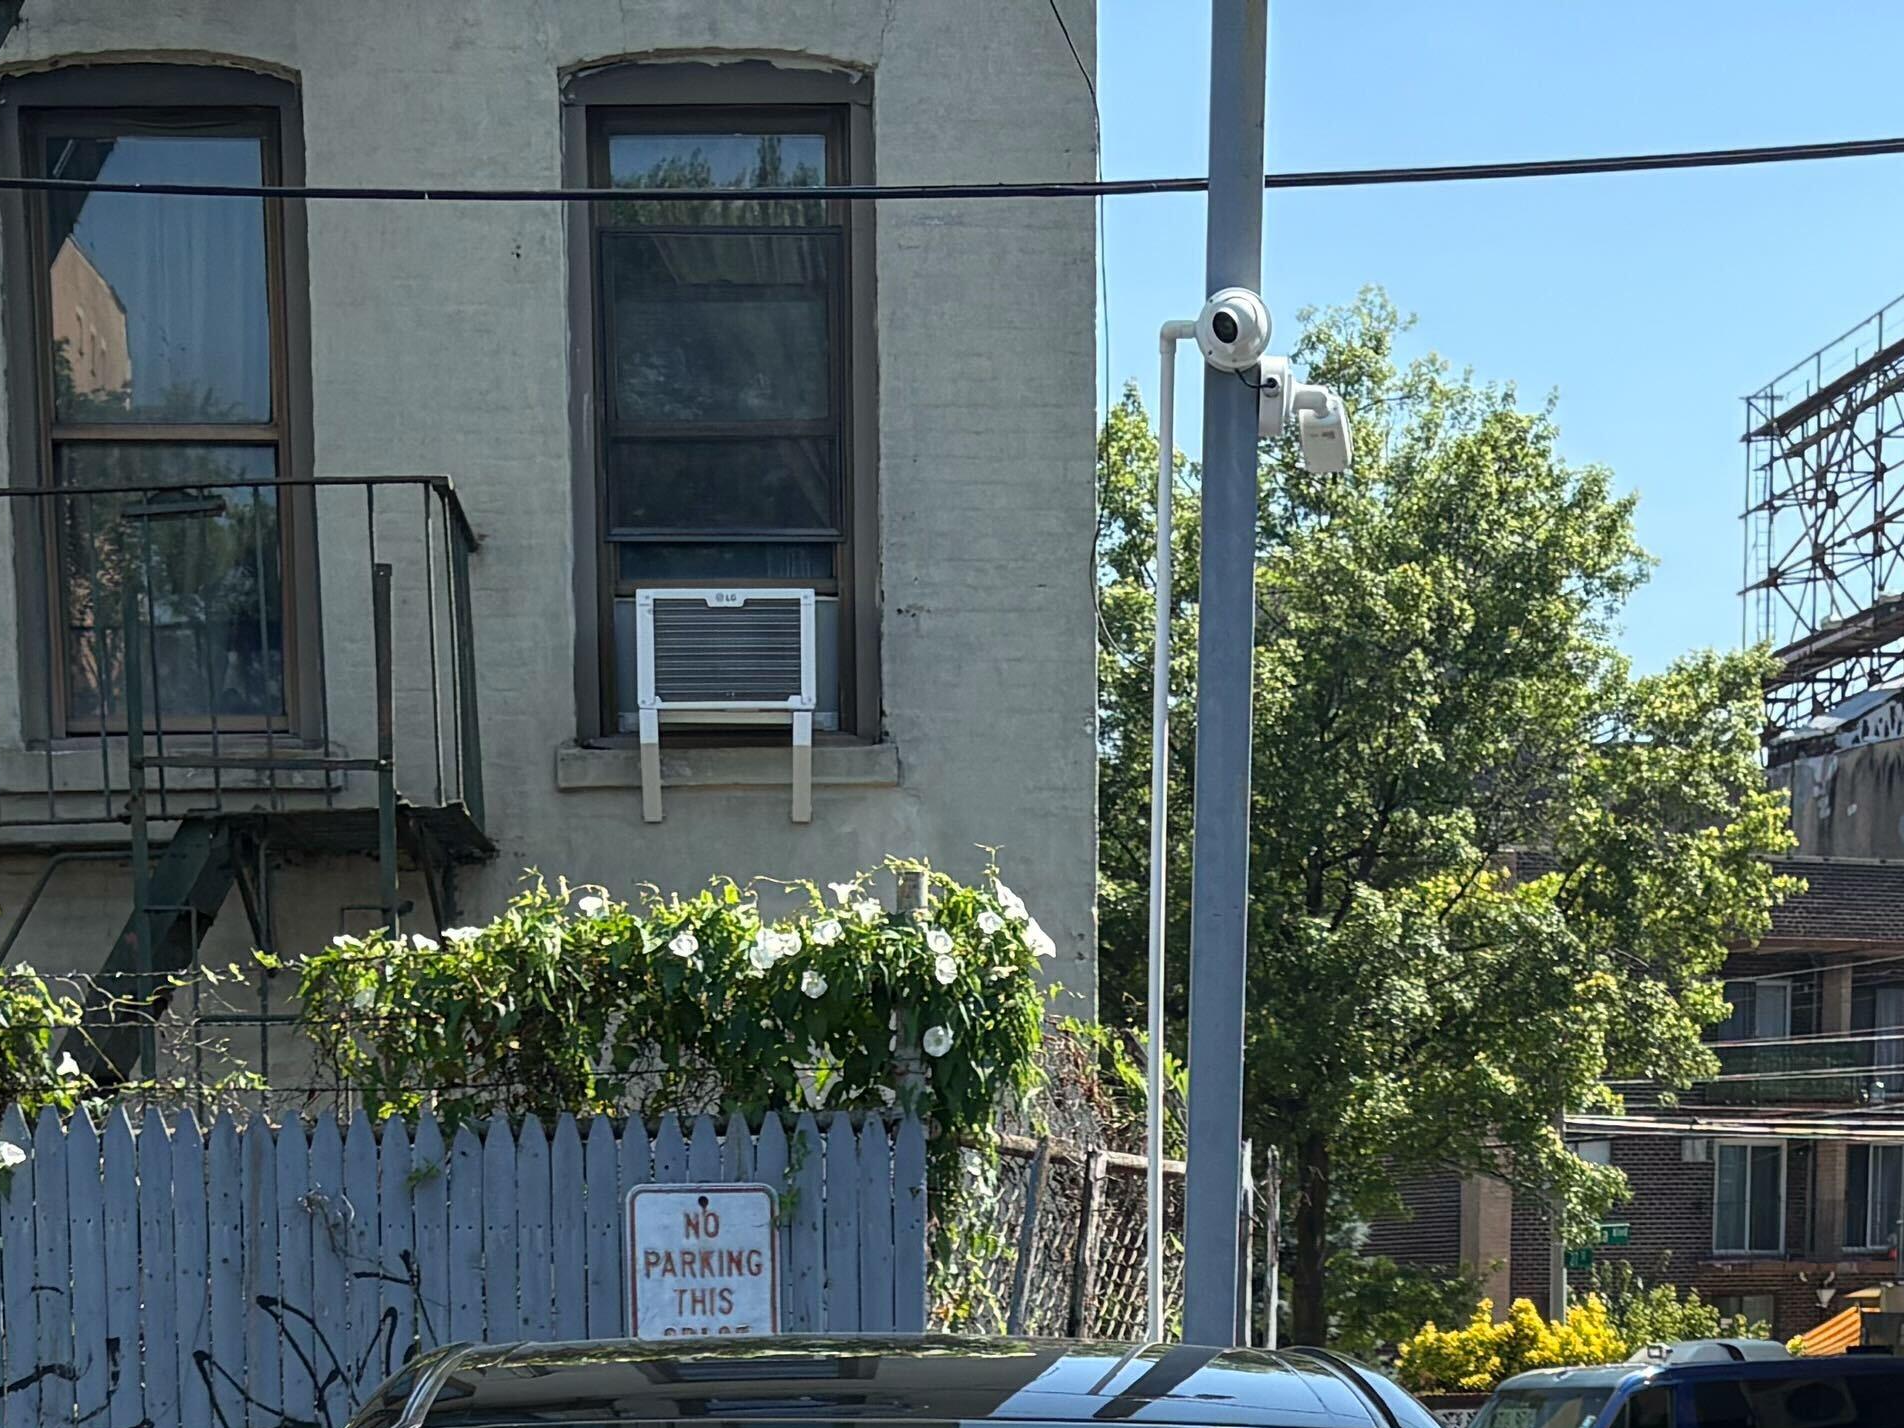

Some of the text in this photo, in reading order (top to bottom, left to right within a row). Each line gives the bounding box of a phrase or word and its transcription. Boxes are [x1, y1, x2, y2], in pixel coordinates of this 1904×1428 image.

[683, 1212, 720, 1240] NO
[643, 1249, 763, 1279] PARKING
[673, 1287, 735, 1317] THIS
